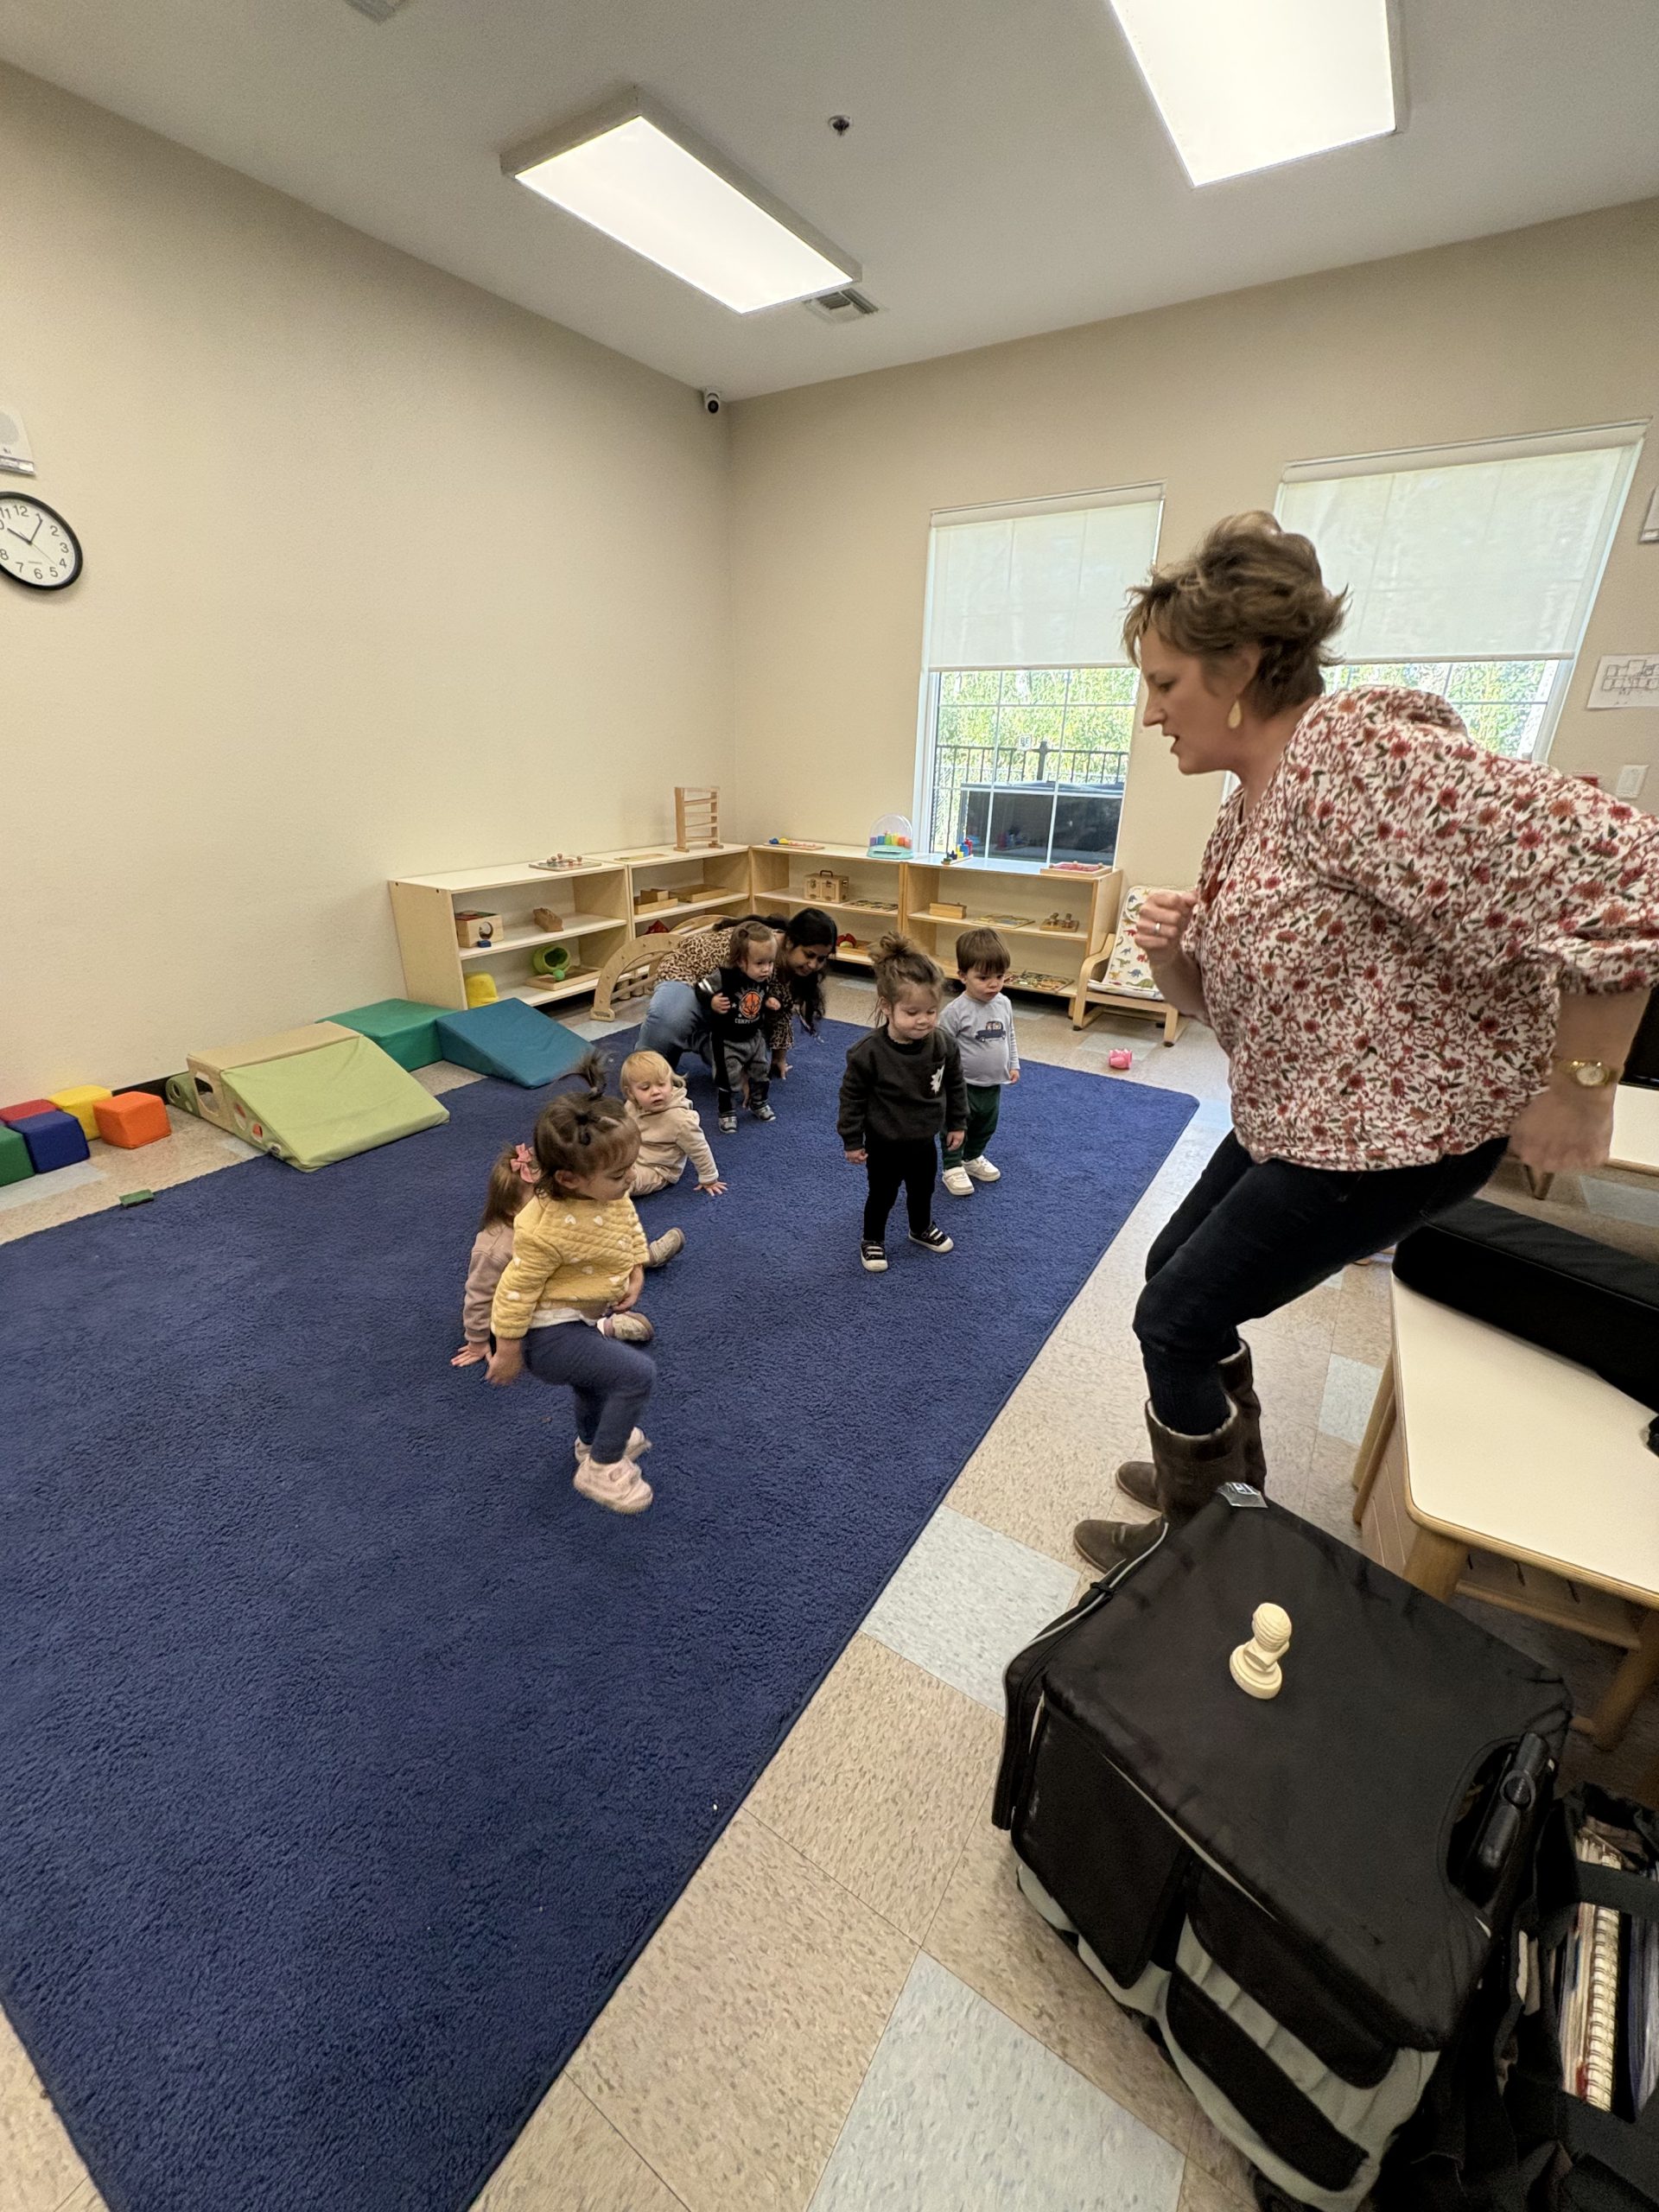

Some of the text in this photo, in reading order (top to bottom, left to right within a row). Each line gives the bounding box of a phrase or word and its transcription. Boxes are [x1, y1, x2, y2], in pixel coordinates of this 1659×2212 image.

[14, 504, 29, 518] 12
[49, 526, 59, 537] 2
[60, 543, 69, 554] 3
[0, 549, 9, 561] 8
[16, 562, 24, 573] 7
[59, 558, 67, 569] 4
[34, 568, 43, 580] 6
[49, 567, 59, 577] 5
